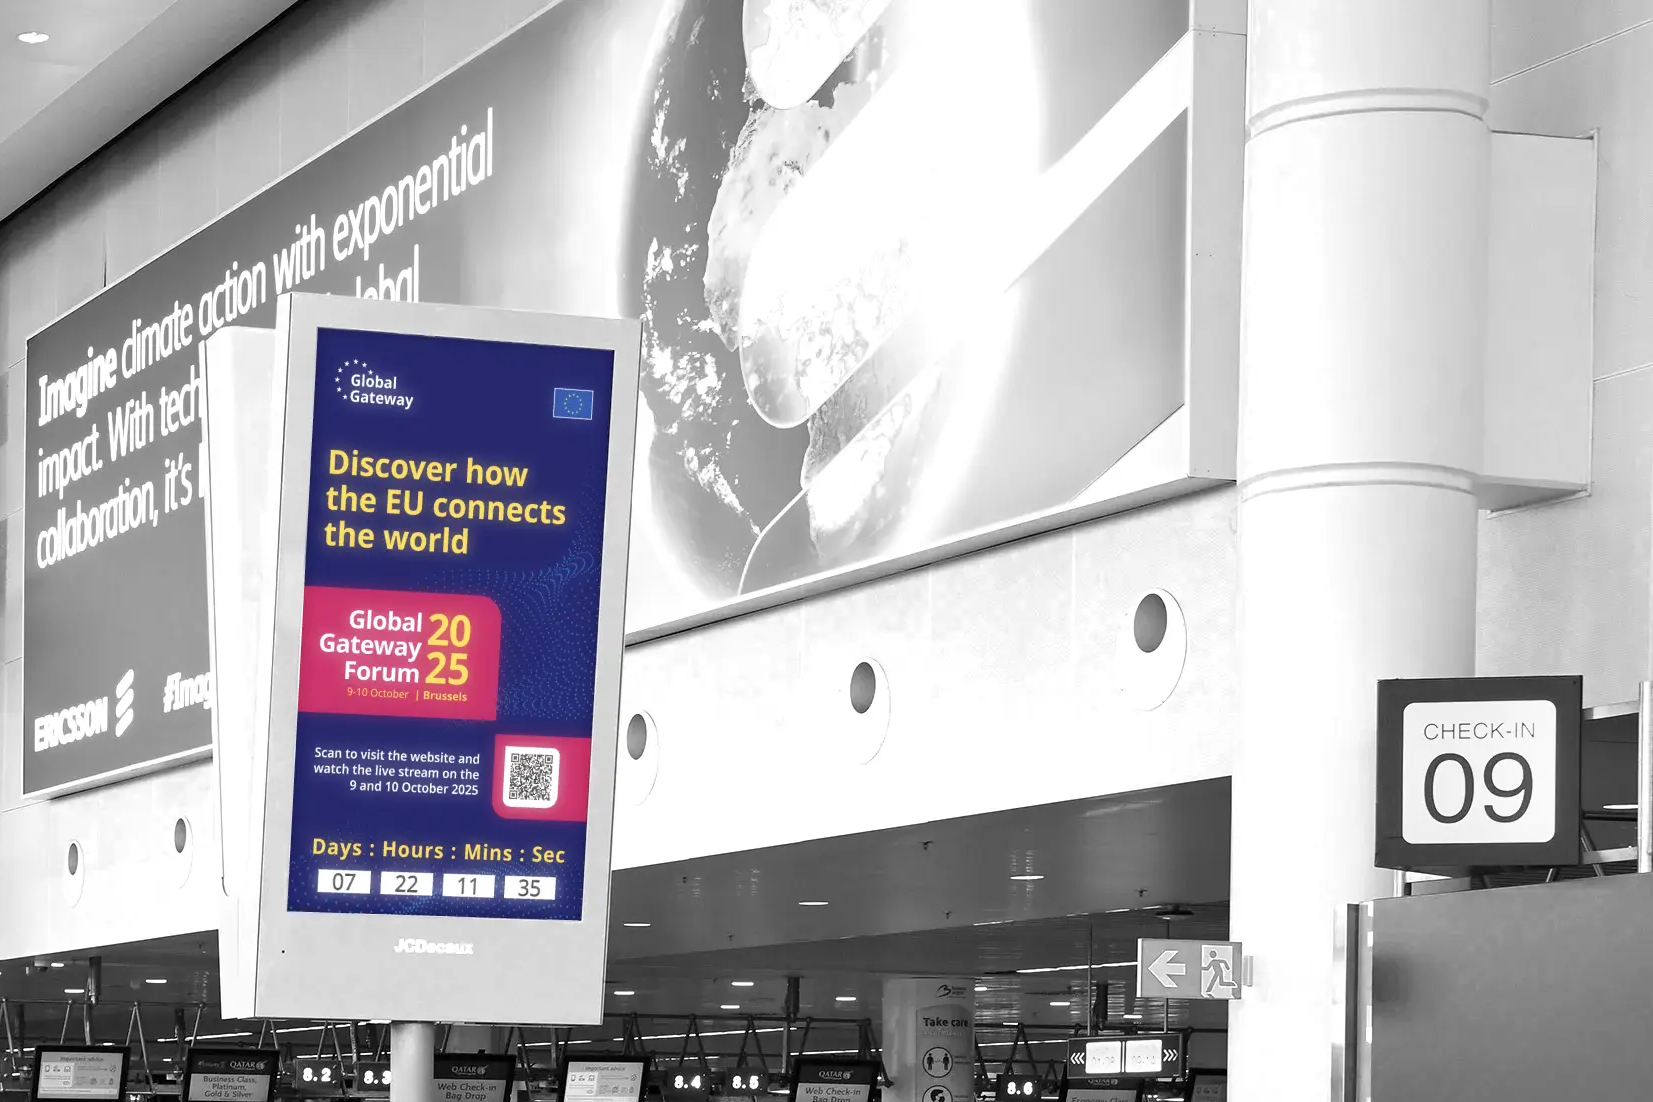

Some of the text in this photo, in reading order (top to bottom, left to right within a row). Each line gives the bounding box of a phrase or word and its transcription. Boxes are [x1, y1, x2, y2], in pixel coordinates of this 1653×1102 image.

[38, 107, 493, 426] Imagine climate action with exponential
[351, 374, 397, 390] Global
[350, 391, 413, 410] Gateway
[39, 365, 203, 500] impact. With tech
[329, 450, 528, 487] Discover how
[37, 478, 158, 568] collaboration,
[165, 452, 192, 513] it's
[327, 486, 566, 525] the EU connects
[325, 522, 469, 554] the world
[349, 610, 422, 632] Global
[428, 614, 471, 647] 20
[320, 634, 422, 661] Gateway
[345, 661, 419, 683] Forum
[425, 652, 469, 685] 25
[163, 672, 212, 713] #Imag
[347, 687, 409, 699] 9-10 October
[423, 691, 467, 702] Brussels
[35, 696, 108, 752] ERICSSON
[1424, 722, 1535, 740] CHECK-IN
[315, 747, 480, 765] Scan to visit the website and
[314, 763, 479, 780] watch the live stream on the
[350, 780, 478, 795] 9 and 10 October 2025
[1424, 752, 1533, 824] 09
[313, 838, 565, 863] Days Hours Mins Sec
[332, 873, 540, 897] 07 22 11 35
[923, 1017, 968, 1028] Take care
[230, 1061, 255, 1069] QATAR
[303, 1067, 331, 1082] 8.2
[452, 1066, 476, 1074] QATAR
[446, 1093, 486, 1101] Bag Drop
[460, 1083, 496, 1091] Check-in
[826, 1087, 861, 1095] Check-in
